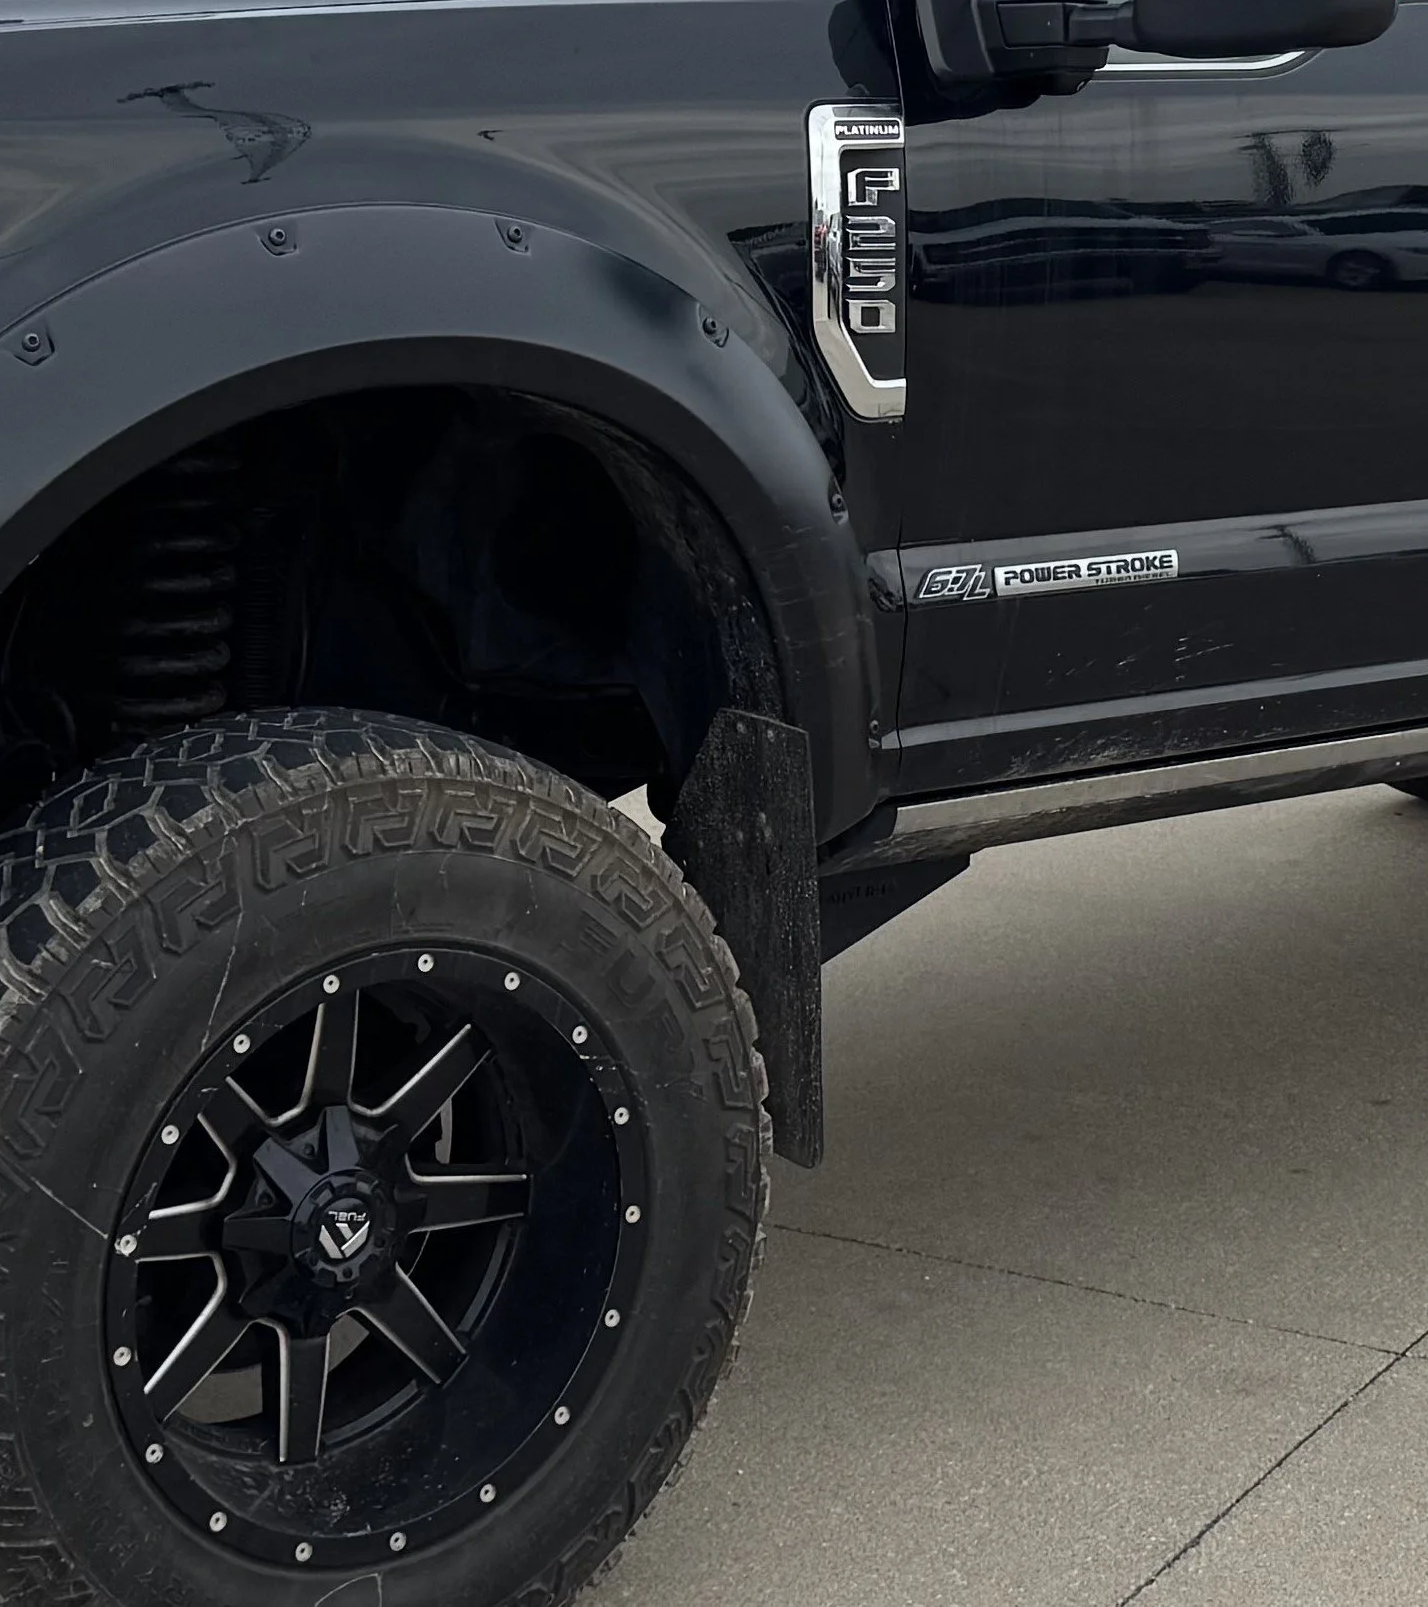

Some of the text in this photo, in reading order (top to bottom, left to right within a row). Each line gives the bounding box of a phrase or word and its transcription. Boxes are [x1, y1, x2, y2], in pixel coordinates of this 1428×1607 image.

[834, 123, 900, 136] PLATINUM
[1004, 557, 1083, 586] POWER
[1086, 554, 1174, 578] STROKE
[327, 1210, 367, 1222] FUEL
